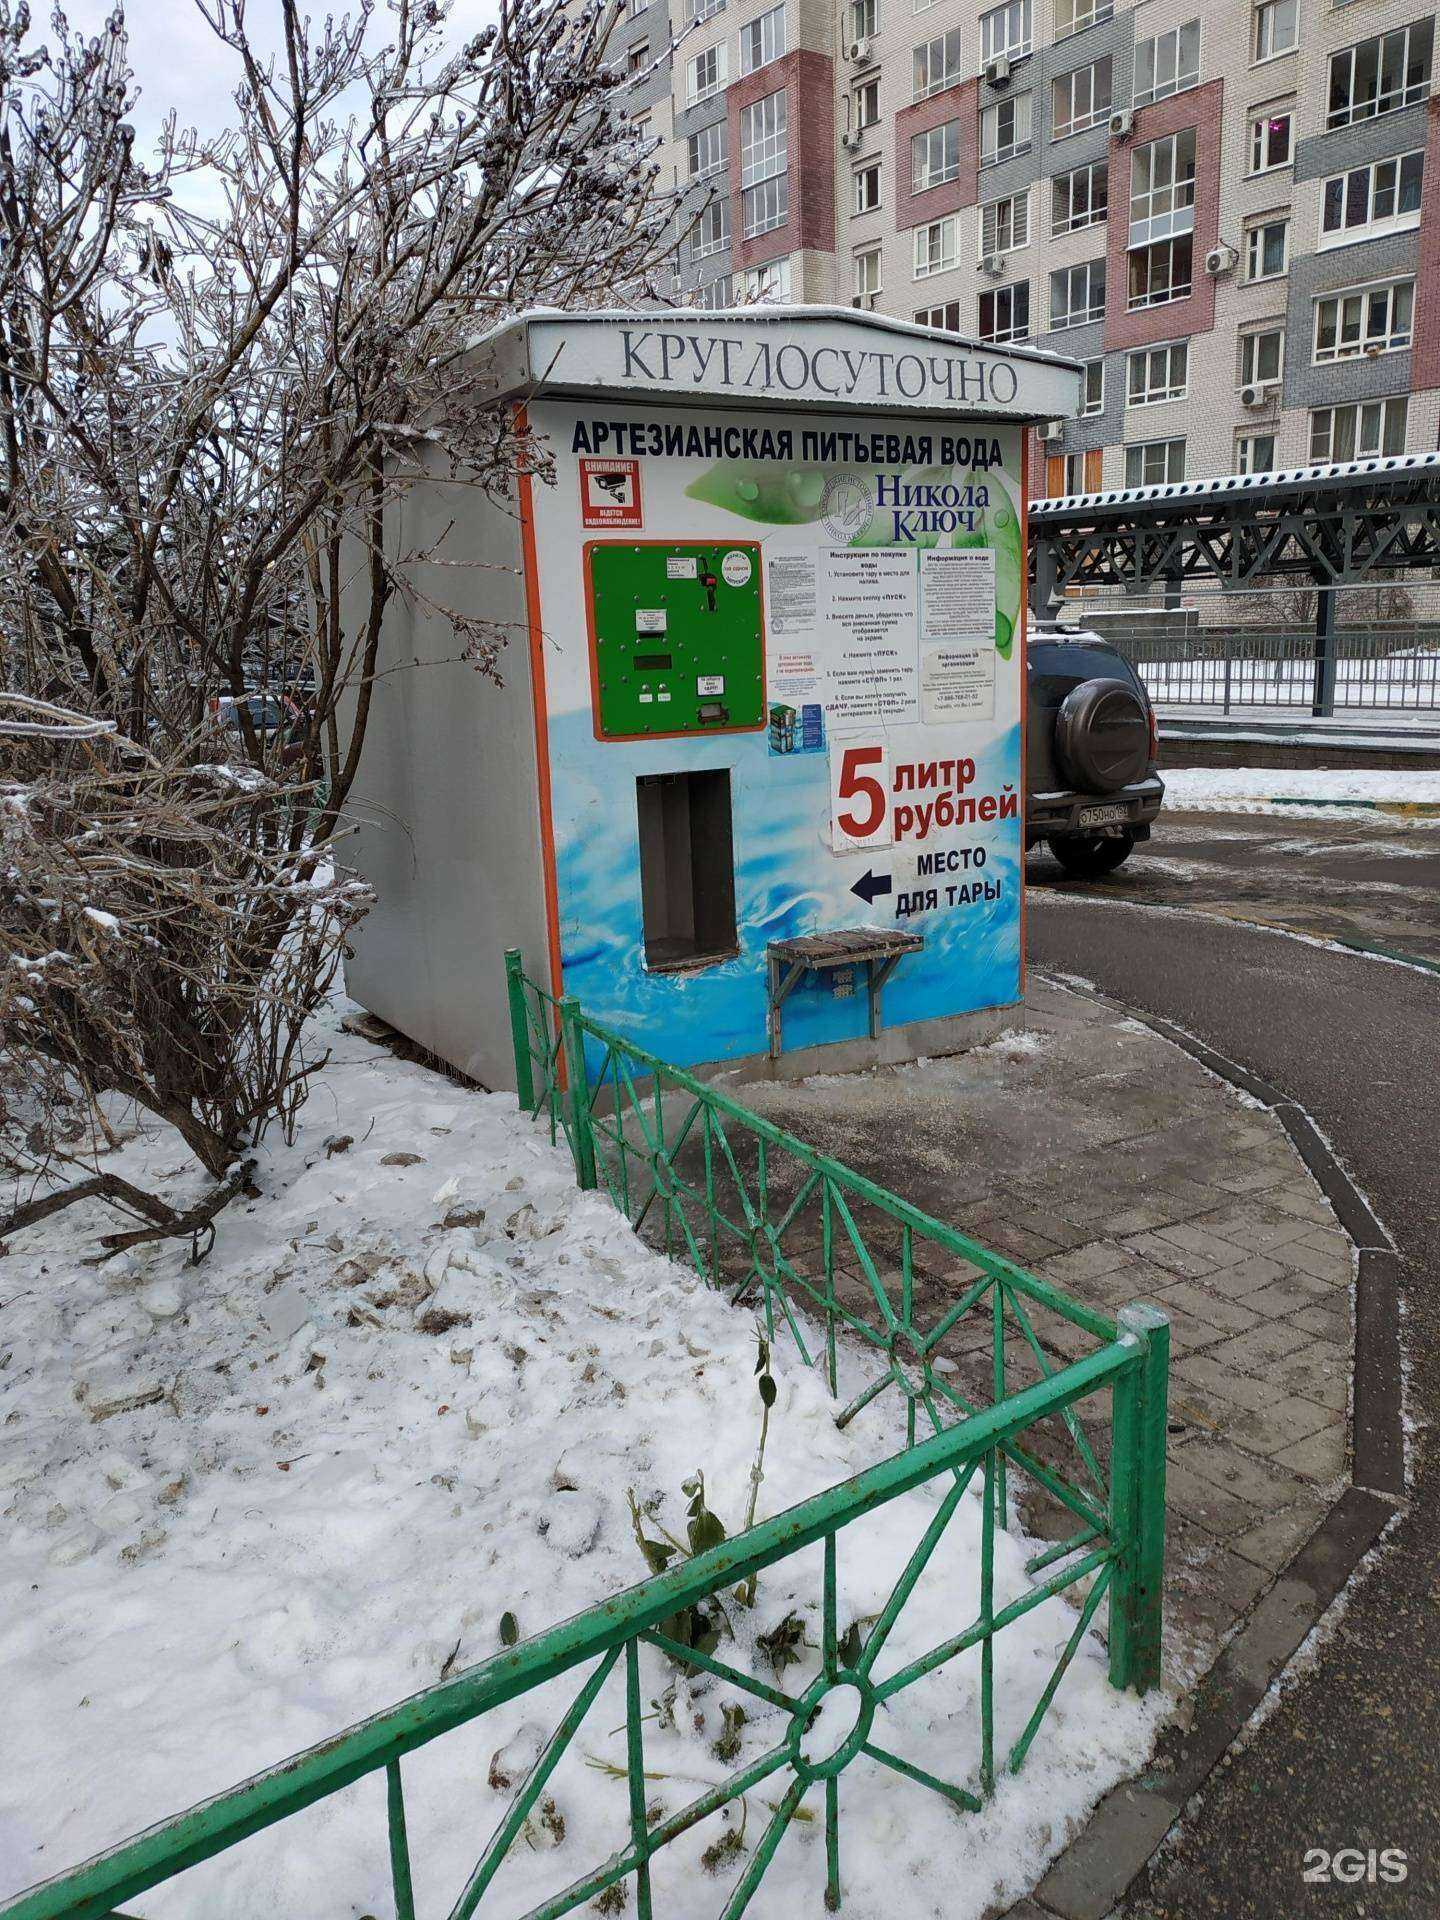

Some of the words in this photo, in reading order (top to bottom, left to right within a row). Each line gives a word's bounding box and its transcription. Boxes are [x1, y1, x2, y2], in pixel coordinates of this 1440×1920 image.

[619, 330, 1019, 404] КРУГЛОСУТОЧНО
[572, 420, 793, 460] АРТЕЗИАНСКАЯ
[802, 431, 932, 465] ПИТЬЕВАЯ
[943, 435, 1004, 472] ВОДА
[584, 461, 633, 472] ВНИМАНИЕ!
[875, 474, 990, 507] Никола
[892, 510, 976, 542] Ключ
[837, 746, 886, 838] 5
[893, 757, 976, 793] литр
[894, 784, 1017, 842] рублей
[917, 846, 987, 876] МЕСТО
[895, 888, 938, 919] ДЛЯ
[945, 879, 1001, 907] ТАРЫ
